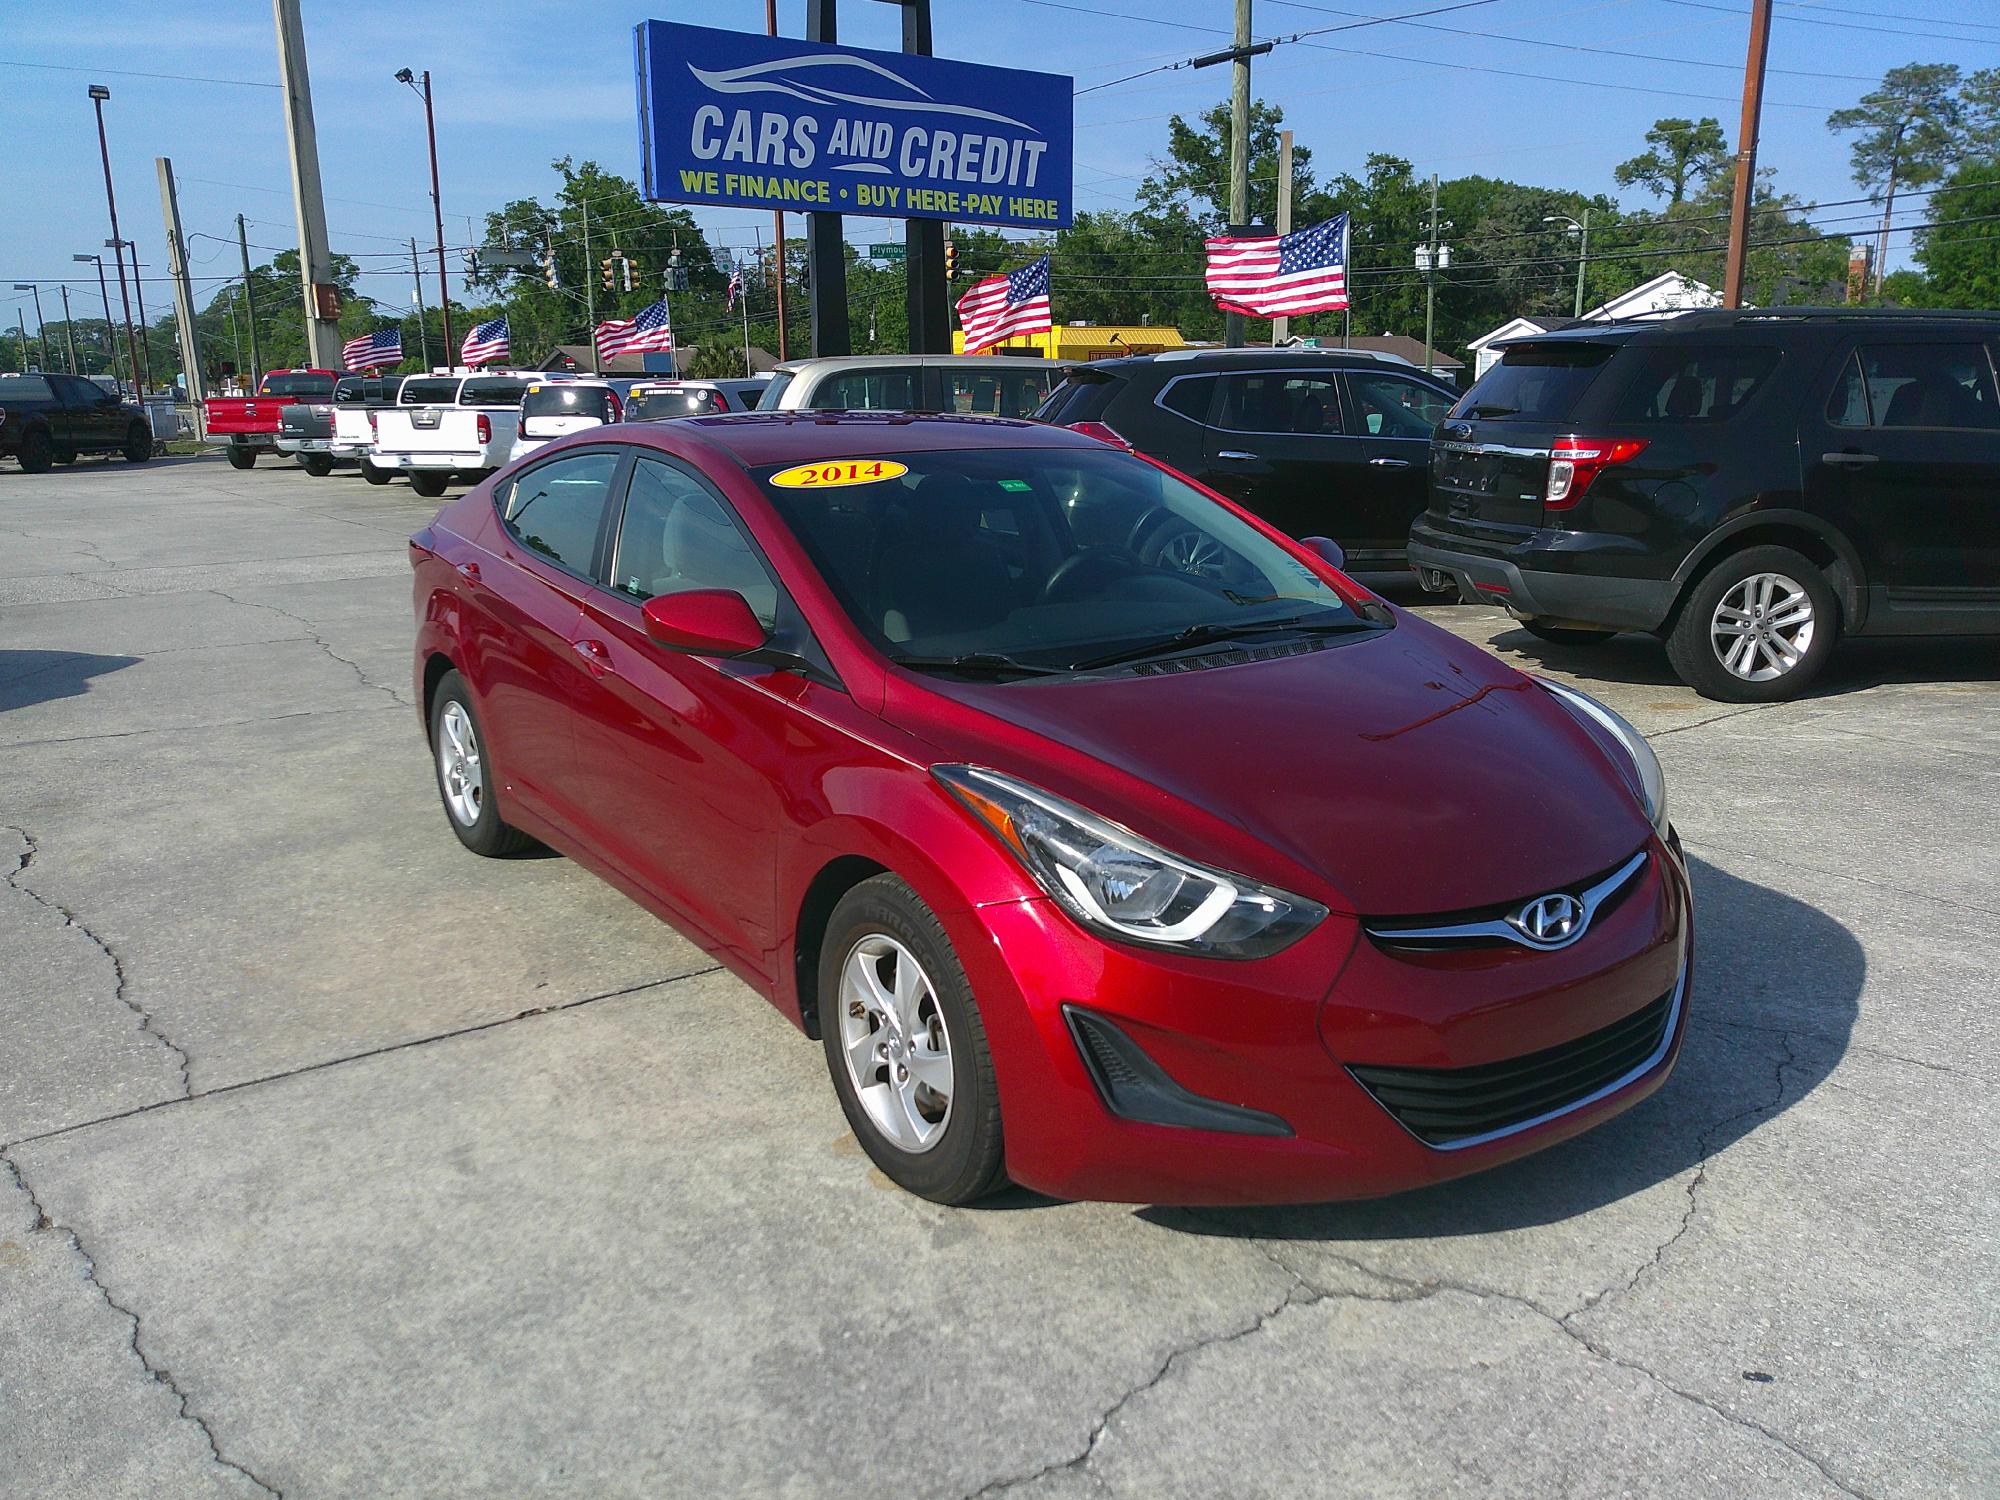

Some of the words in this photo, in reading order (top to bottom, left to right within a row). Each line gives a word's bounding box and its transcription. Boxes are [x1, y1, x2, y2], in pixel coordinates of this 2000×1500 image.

[690, 104, 819, 169] CARS
[826, 118, 894, 159] AND
[899, 126, 1048, 188] CREDIT
[679, 169, 719, 195] WE
[725, 173, 831, 204] FINANCE
[857, 184, 901, 208] BUY
[1009, 197, 1059, 220] HERE
[801, 462, 883, 485] 2014
